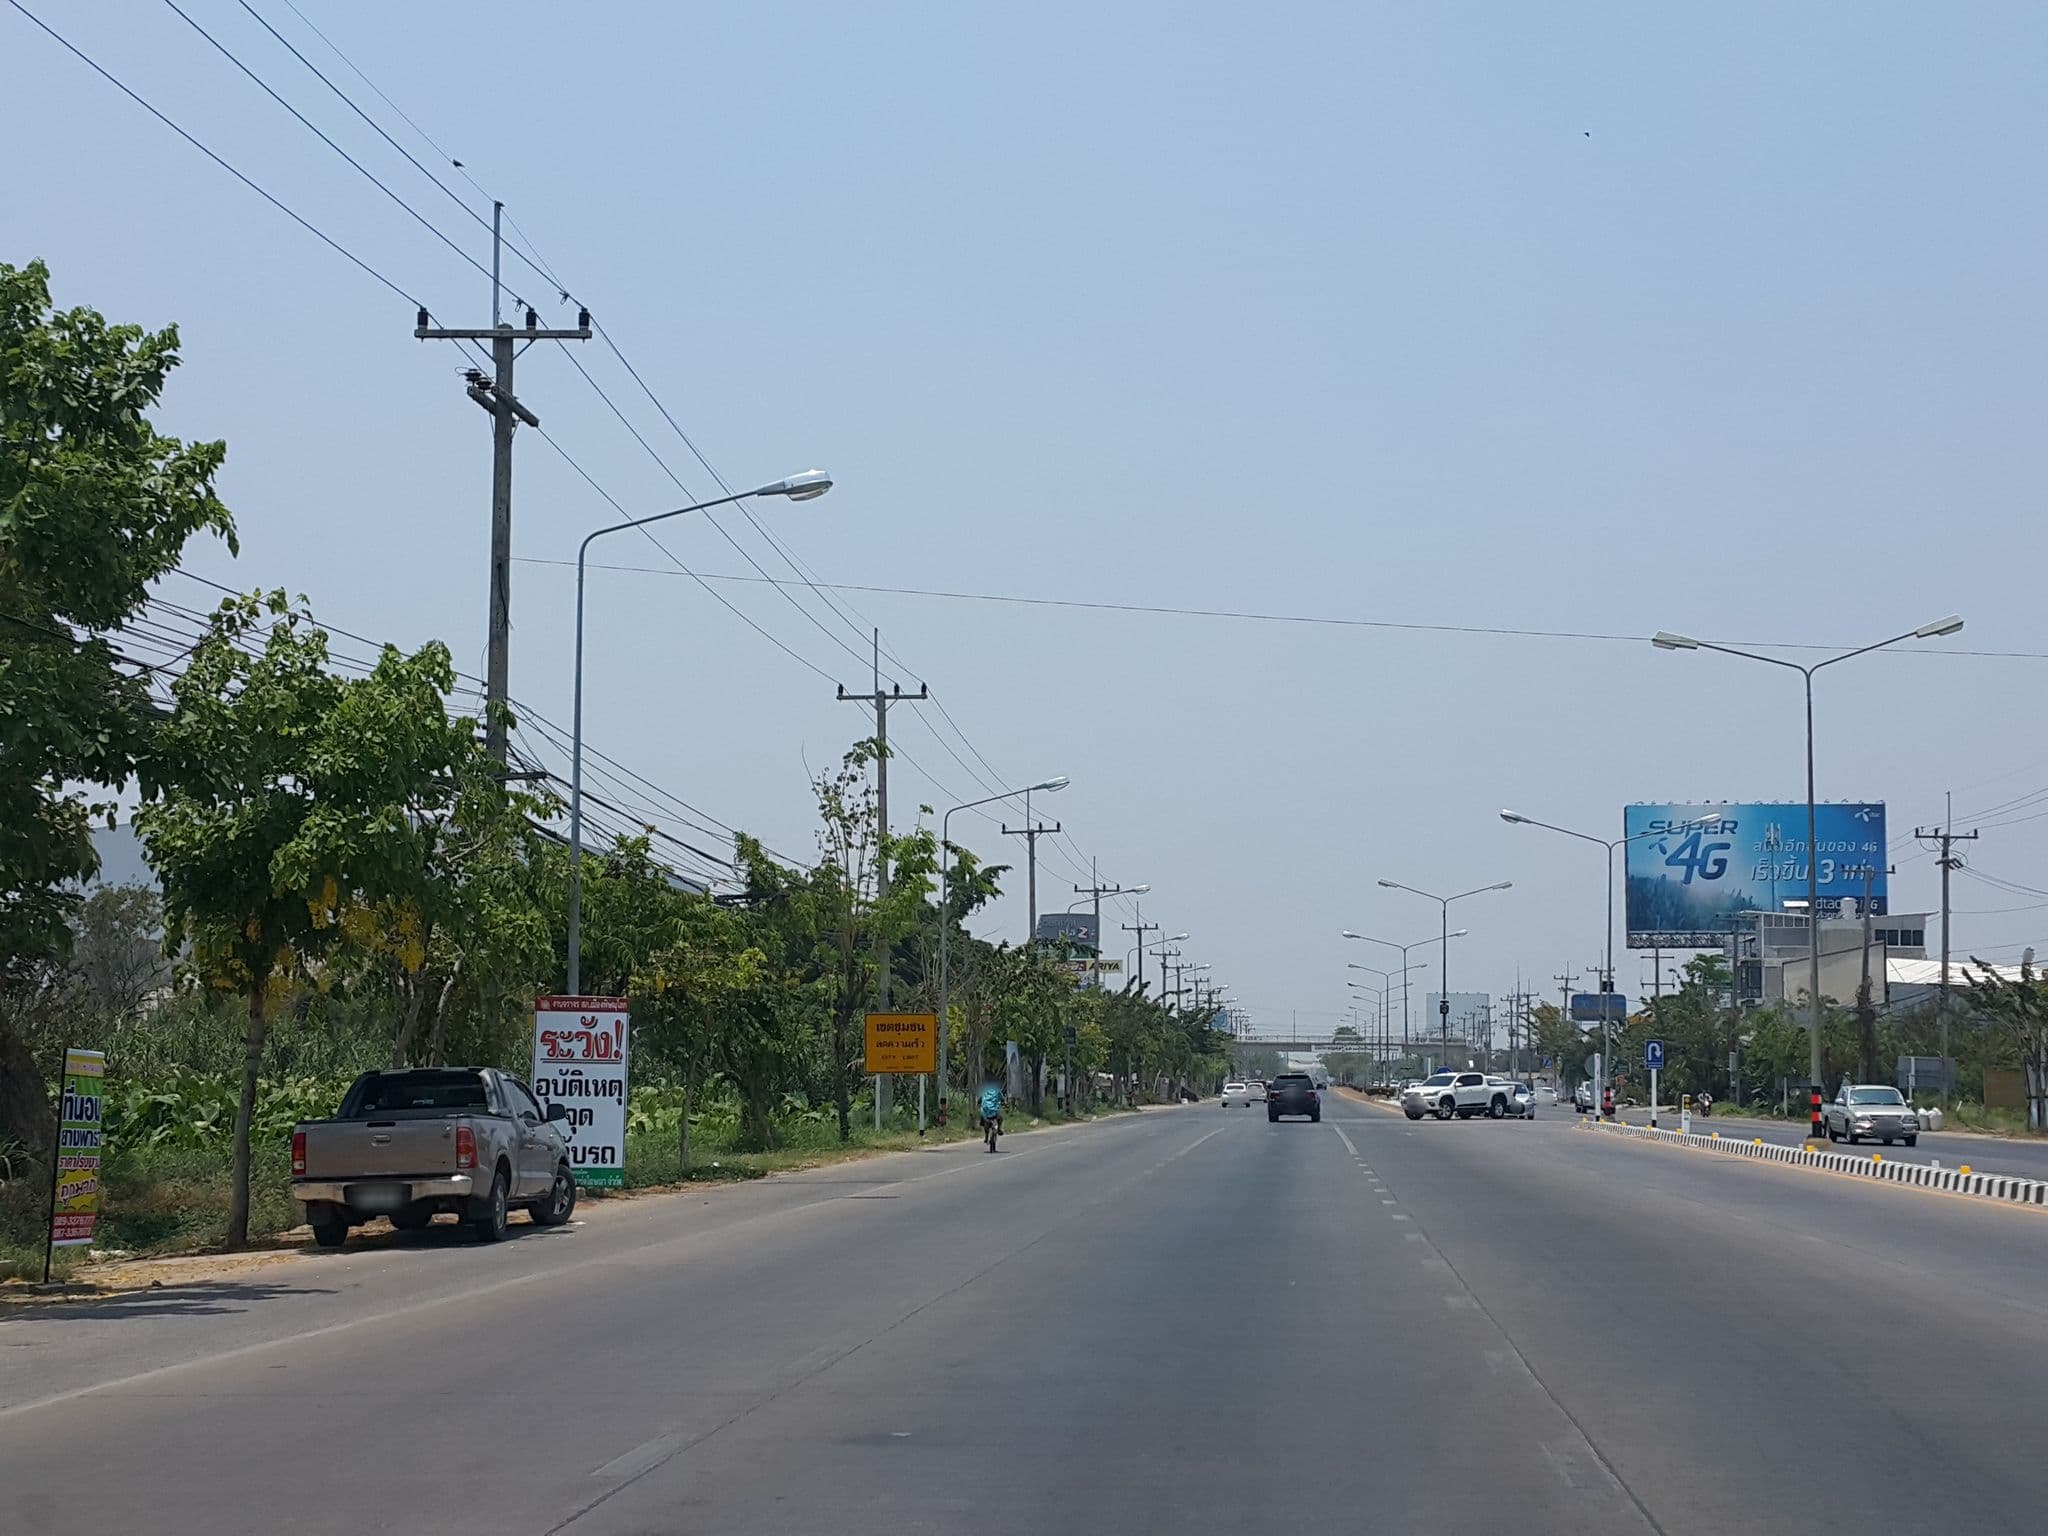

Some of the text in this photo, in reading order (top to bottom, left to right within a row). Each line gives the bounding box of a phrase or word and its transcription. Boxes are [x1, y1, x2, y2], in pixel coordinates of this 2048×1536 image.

[1648, 819, 1739, 838] SUPER
[1664, 832, 1732, 885] 4G
[1861, 841, 1878, 853] 4G
[1817, 858, 1836, 884] 3
[1088, 962, 1120, 971] ARIYA
[539, 1014, 625, 1060] ระวัง!
[875, 1021, 926, 1036] เขตชุมชน
[535, 1068, 624, 1106] อุบัติเหตุ
[564, 1107, 594, 1134] จุด
